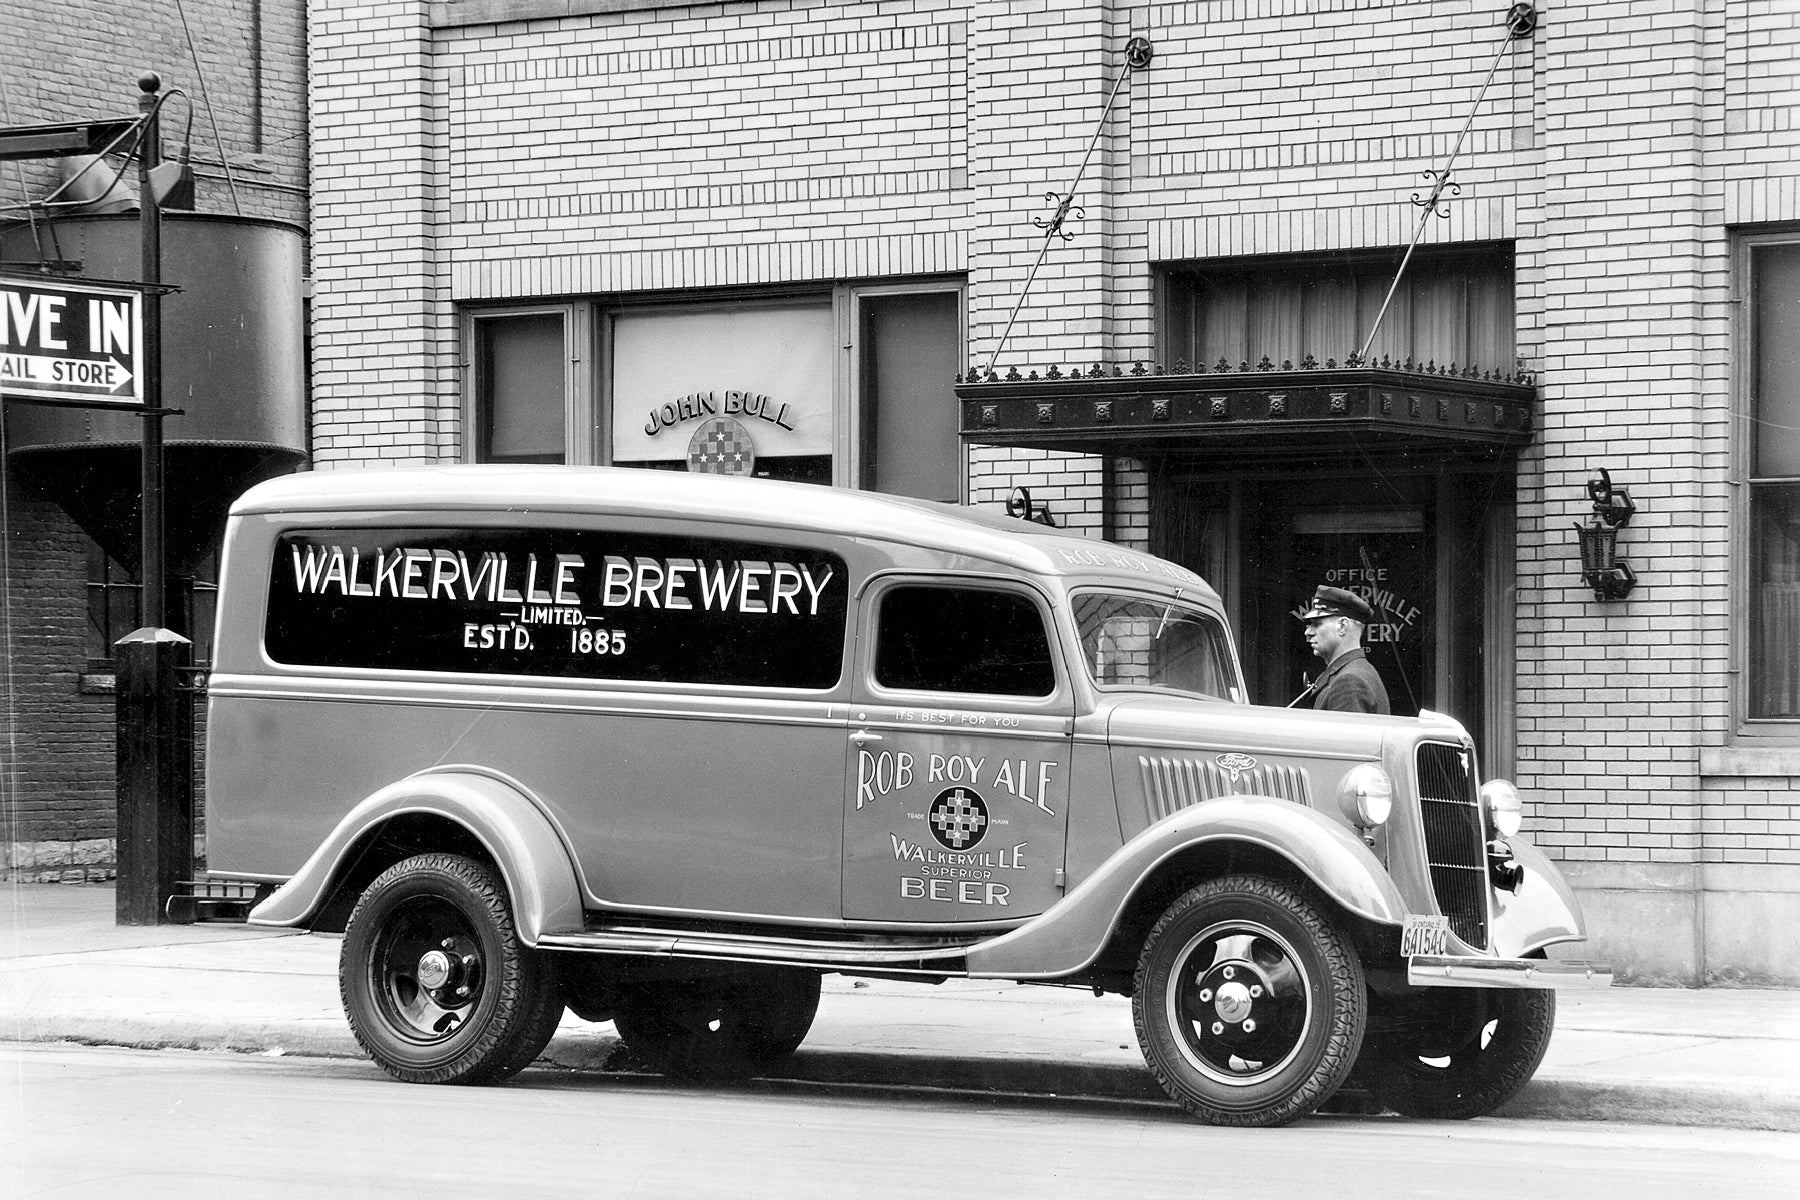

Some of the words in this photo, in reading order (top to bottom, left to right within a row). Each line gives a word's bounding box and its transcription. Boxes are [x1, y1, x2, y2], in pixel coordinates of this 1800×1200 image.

[89, 299, 130, 355] IN
[52, 361, 117, 385] STORE
[645, 391, 716, 436] JOHN
[724, 390, 798, 431] BULL
[291, 544, 585, 604] WALKERVILLE
[601, 555, 833, 615] BREWERY
[1326, 568, 1388, 582] OFFICE
[571, 627, 626, 655] 1885
[921, 711, 955, 723] BEST
[961, 715, 987, 725] FOR
[993, 717, 1020, 727] YOU
[856, 750, 914, 810] ROB
[928, 753, 986, 784] ROY
[993, 758, 1058, 817] ALE
[907, 812, 925, 820] TRADE
[890, 832, 1028, 870] WALKERVILLE
[921, 865, 992, 880] SUPERIOR
[901, 876, 1011, 906] BEER
